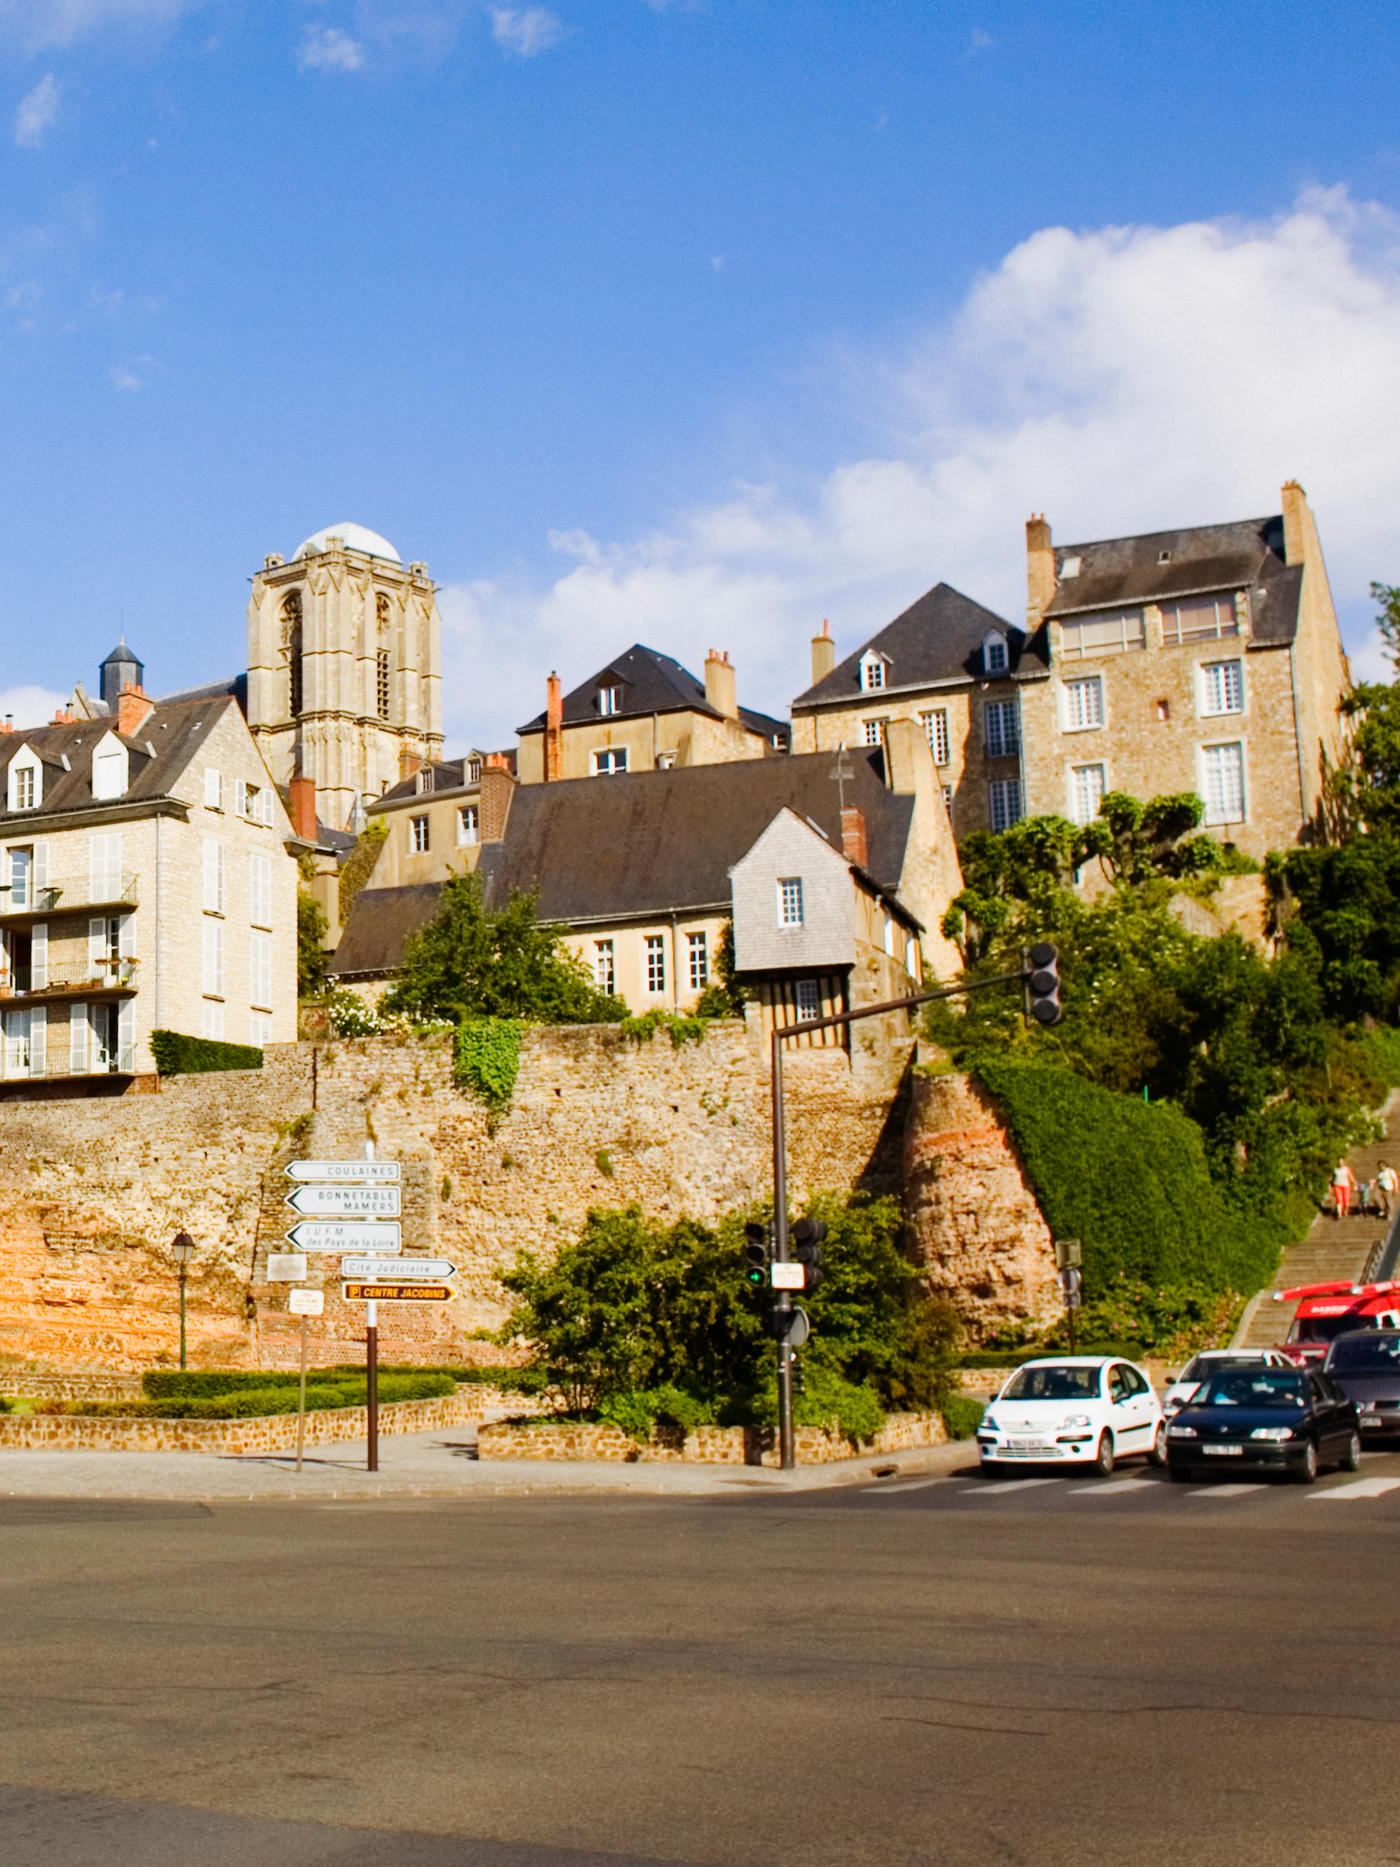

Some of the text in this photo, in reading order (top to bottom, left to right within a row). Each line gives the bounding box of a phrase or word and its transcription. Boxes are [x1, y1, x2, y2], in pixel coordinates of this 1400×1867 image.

[327, 1166, 394, 1176] COULAINES
[318, 1191, 393, 1200] BONNETABLE
[344, 1202, 394, 1211] MAMERS
[306, 1238, 394, 1248] des Pays de la Loire
[376, 1263, 430, 1273] Judiciaire
[363, 1287, 399, 1298] CENTRE
[400, 1287, 446, 1298] JACOBINS
